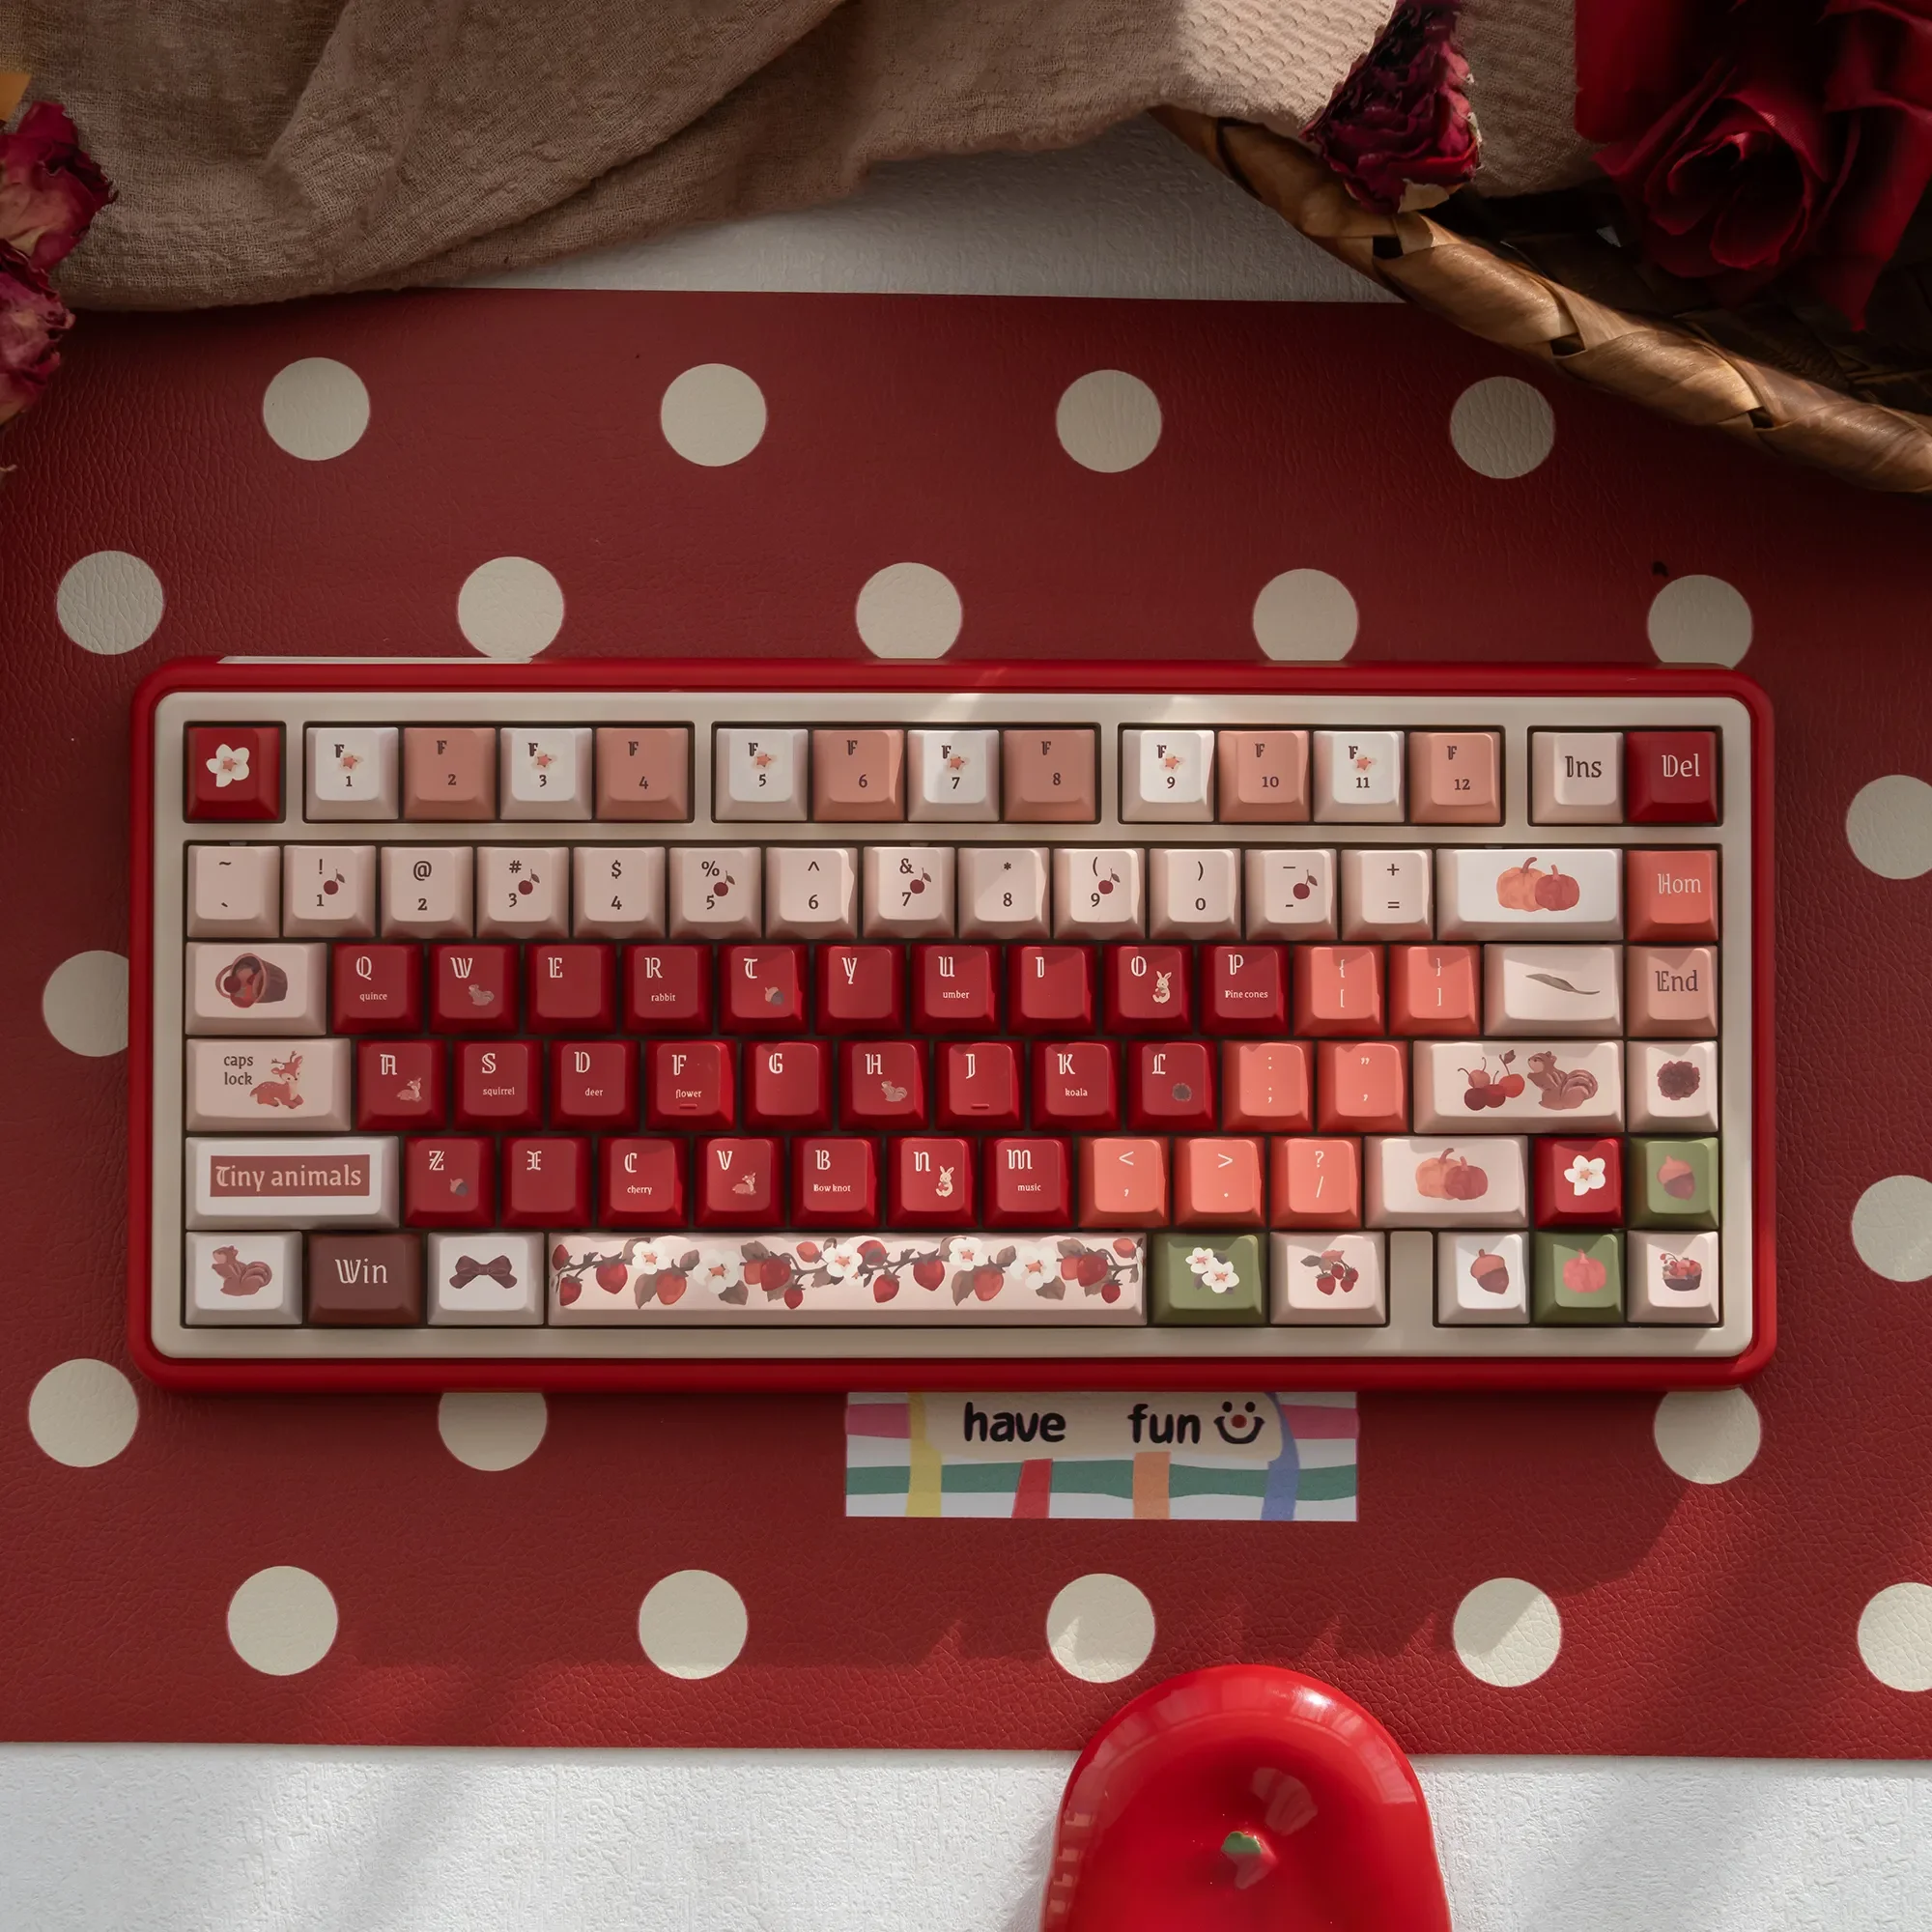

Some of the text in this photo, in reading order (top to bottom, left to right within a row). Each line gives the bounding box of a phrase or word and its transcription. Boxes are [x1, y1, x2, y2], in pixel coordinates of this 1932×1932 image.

[333, 743, 345, 759] F
[436, 740, 447, 755] F
[527, 742, 539, 758] F
[627, 741, 639, 757] F
[748, 742, 759, 758] F
[846, 739, 859, 756] F
[941, 745, 952, 761] F
[1040, 740, 1052, 756] F
[1156, 744, 1168, 760] F
[1254, 743, 1265, 758] F
[1348, 745, 1359, 761] F
[1446, 745, 1458, 761] F
[1564, 755, 1603, 779] Ins
[1661, 753, 1700, 778] Del
[345, 775, 353, 787] 1
[447, 773, 457, 786] 2
[539, 774, 548, 788] 3
[639, 776, 649, 790] 4
[758, 773, 767, 787] 5
[858, 773, 868, 788] 6
[952, 776, 961, 790] 7
[1052, 772, 1062, 786] 8
[1166, 776, 1176, 789] 9
[1262, 776, 1280, 788] 10
[1355, 777, 1371, 789] 11
[1454, 778, 1471, 791] 12
[412, 860, 433, 882] @
[508, 860, 523, 874] #
[611, 859, 622, 880] $
[700, 860, 721, 877] %
[898, 857, 915, 874] &
[1386, 863, 1400, 876] +
[1657, 872, 1702, 895] Hom
[316, 894, 325, 907] 1
[417, 897, 428, 911] 2
[508, 892, 518, 908] 3
[611, 895, 623, 911] 4
[706, 894, 716, 910] 5
[808, 894, 819, 910] 6
[901, 891, 912, 907] 7
[1003, 892, 1013, 907] 8
[1090, 892, 1101, 908] 9
[1195, 897, 1207, 911] 0
[355, 955, 373, 981] Q
[449, 956, 473, 980] W
[547, 956, 563, 979] E
[644, 956, 664, 979] R
[743, 957, 758, 980] T
[841, 956, 858, 985] Y
[938, 955, 955, 978] U
[1130, 955, 1148, 978] O
[1227, 953, 1244, 976] P
[1655, 969, 1699, 992] End
[359, 991, 388, 1003] quince
[651, 992, 676, 1002] rabbit
[942, 989, 970, 999] umber
[1224, 989, 1268, 999] Pine cones
[223, 1055, 254, 1070] caps
[380, 1053, 398, 1076] A
[481, 1052, 497, 1074] S
[574, 1051, 591, 1073] D
[671, 1054, 687, 1076] F
[768, 1052, 783, 1074] G
[865, 1053, 883, 1075] H
[965, 1053, 976, 1080] J
[1057, 1053, 1076, 1075] K
[224, 1071, 253, 1086] lock
[482, 1086, 515, 1097] squirrel
[584, 1087, 604, 1096] deer
[675, 1089, 702, 1099] flower
[1065, 1087, 1088, 1097] koala
[428, 1150, 445, 1171] Z
[624, 1151, 638, 1174] C
[716, 1150, 733, 1171] V
[814, 1150, 832, 1171] B
[1119, 1151, 1134, 1166] <
[1217, 1152, 1234, 1169] >
[1315, 1150, 1324, 1168] ?
[214, 1163, 361, 1192] Tiny animals
[626, 1184, 653, 1196] cherry
[812, 1183, 851, 1192] Bow knot
[1017, 1182, 1041, 1192] music
[1316, 1176, 1324, 1199] /
[334, 1258, 388, 1284] Win
[963, 1401, 1202, 1444] have fun
